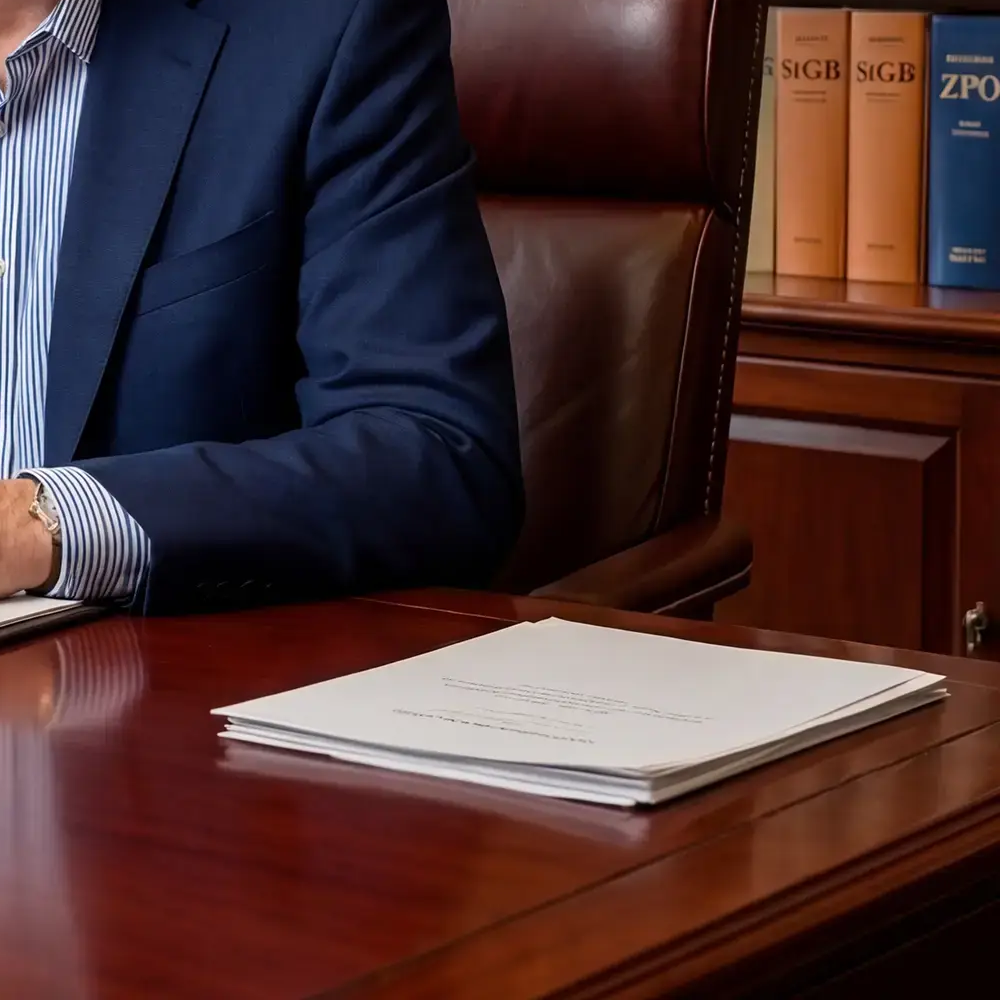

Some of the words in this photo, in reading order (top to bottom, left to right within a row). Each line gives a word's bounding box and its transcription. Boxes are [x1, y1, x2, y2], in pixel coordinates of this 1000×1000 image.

[781, 58, 841, 81] StGB
[856, 61, 916, 84] StGB
[939, 73, 1000, 102] ZPO
